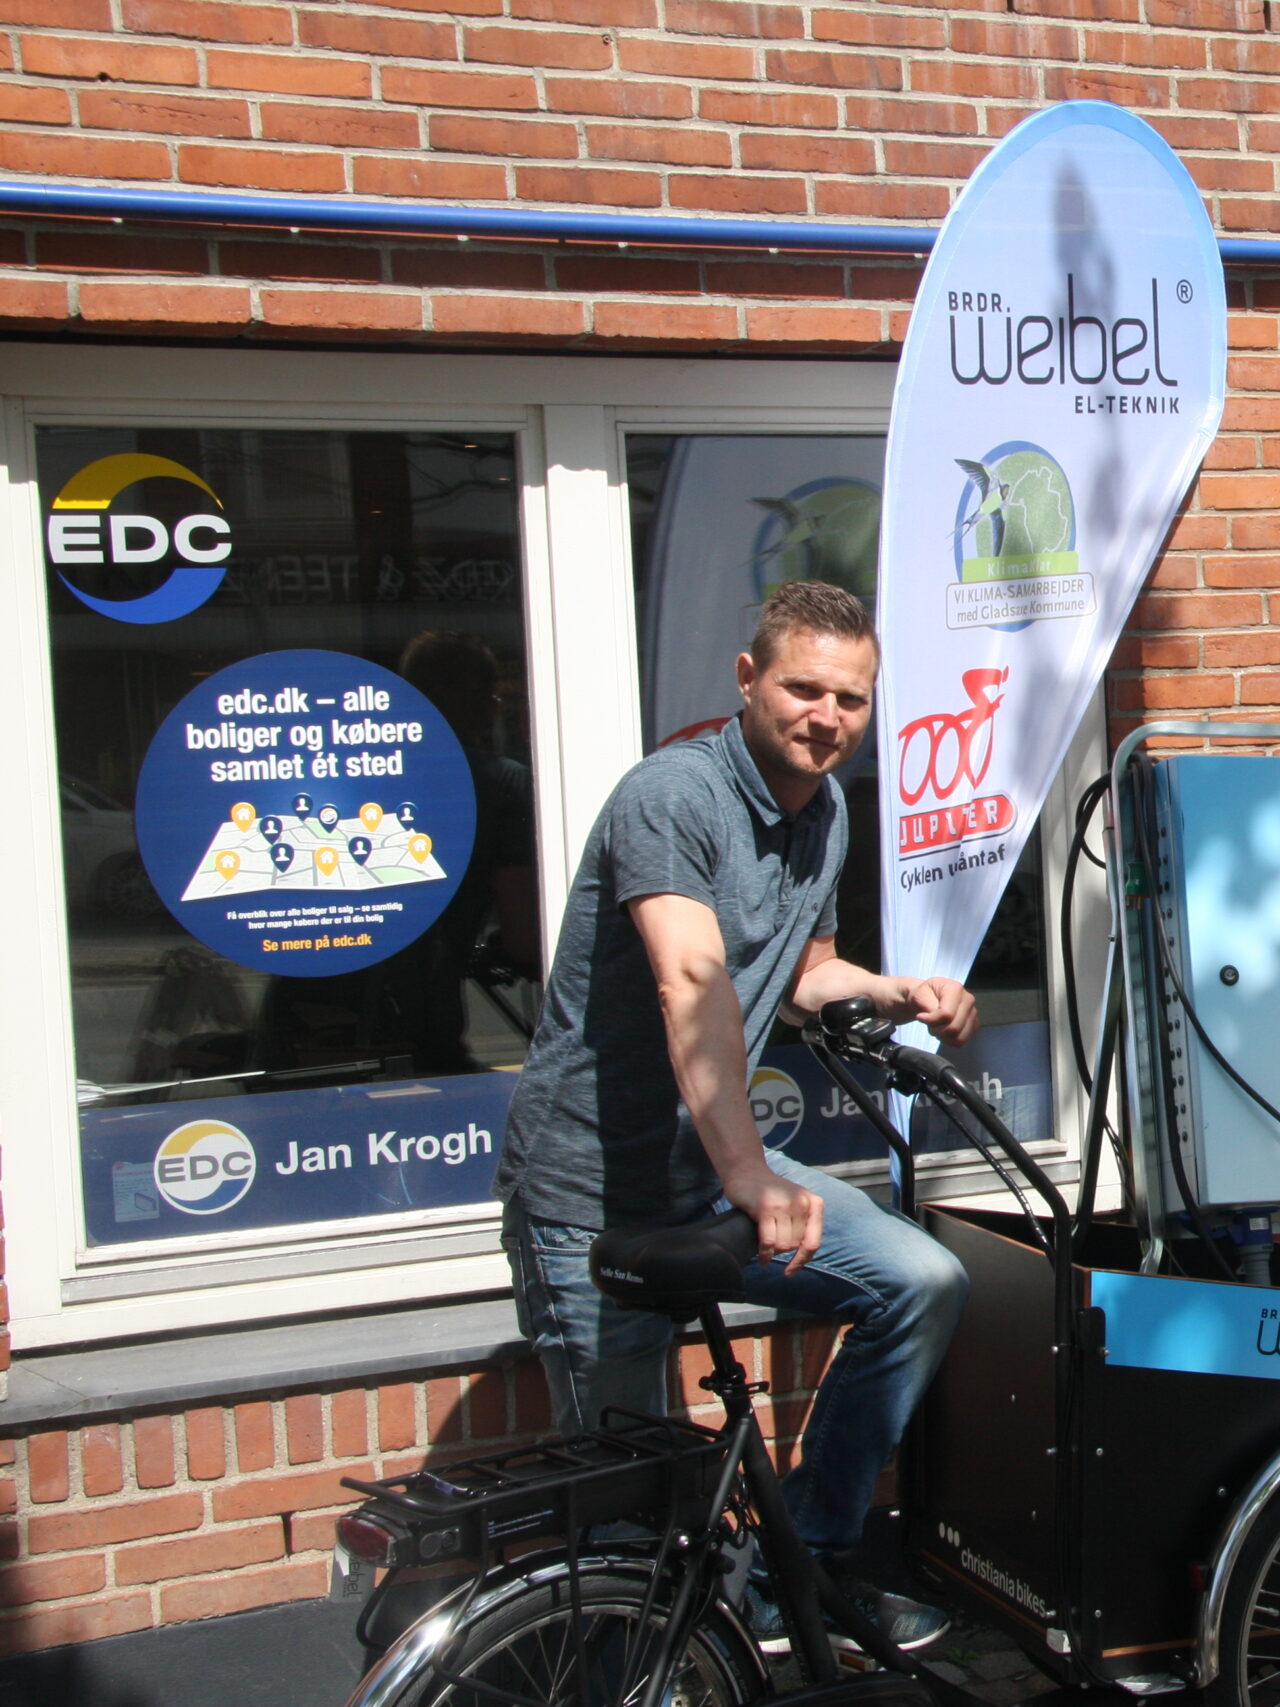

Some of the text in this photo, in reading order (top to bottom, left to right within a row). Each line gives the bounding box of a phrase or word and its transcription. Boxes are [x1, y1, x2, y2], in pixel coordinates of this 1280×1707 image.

[949, 291, 1011, 313] BRDR.
[1075, 395, 1180, 414] EL-TEKNIK
[48, 513, 232, 564] EDC
[954, 578, 1084, 604] VI KLIMA-SAMARBEJDER
[957, 606, 978, 623] med
[1030, 599, 1085, 615] Kommune
[218, 688, 310, 715] edc.dk
[343, 685, 390, 712] alle
[186, 718, 423, 753] boliger og købere
[210, 750, 403, 782] samlet ét sted
[901, 865, 943, 893] Cyklen
[227, 910, 237, 920] Få
[238, 909, 268, 920] overblik
[269, 910, 286, 918] over
[287, 908, 302, 917] alle
[302, 906, 327, 917] boliger
[328, 905, 337, 914] til
[338, 905, 354, 915] salg
[371, 902, 403, 911] samtidig
[248, 921, 266, 930] hvor
[266, 920, 293, 929] mange
[321, 917, 333, 925] der
[343, 915, 351, 924] til
[352, 915, 365, 923] din
[365, 913, 384, 923] bolig
[262, 933, 373, 952] Se mere på edc.dk
[752, 1096, 800, 1122] DC
[820, 1087, 885, 1118] Jan
[275, 1123, 493, 1175] Jan Krogh
[158, 1150, 253, 1184] EDC
[961, 1548, 1047, 1618] christiania bikes
